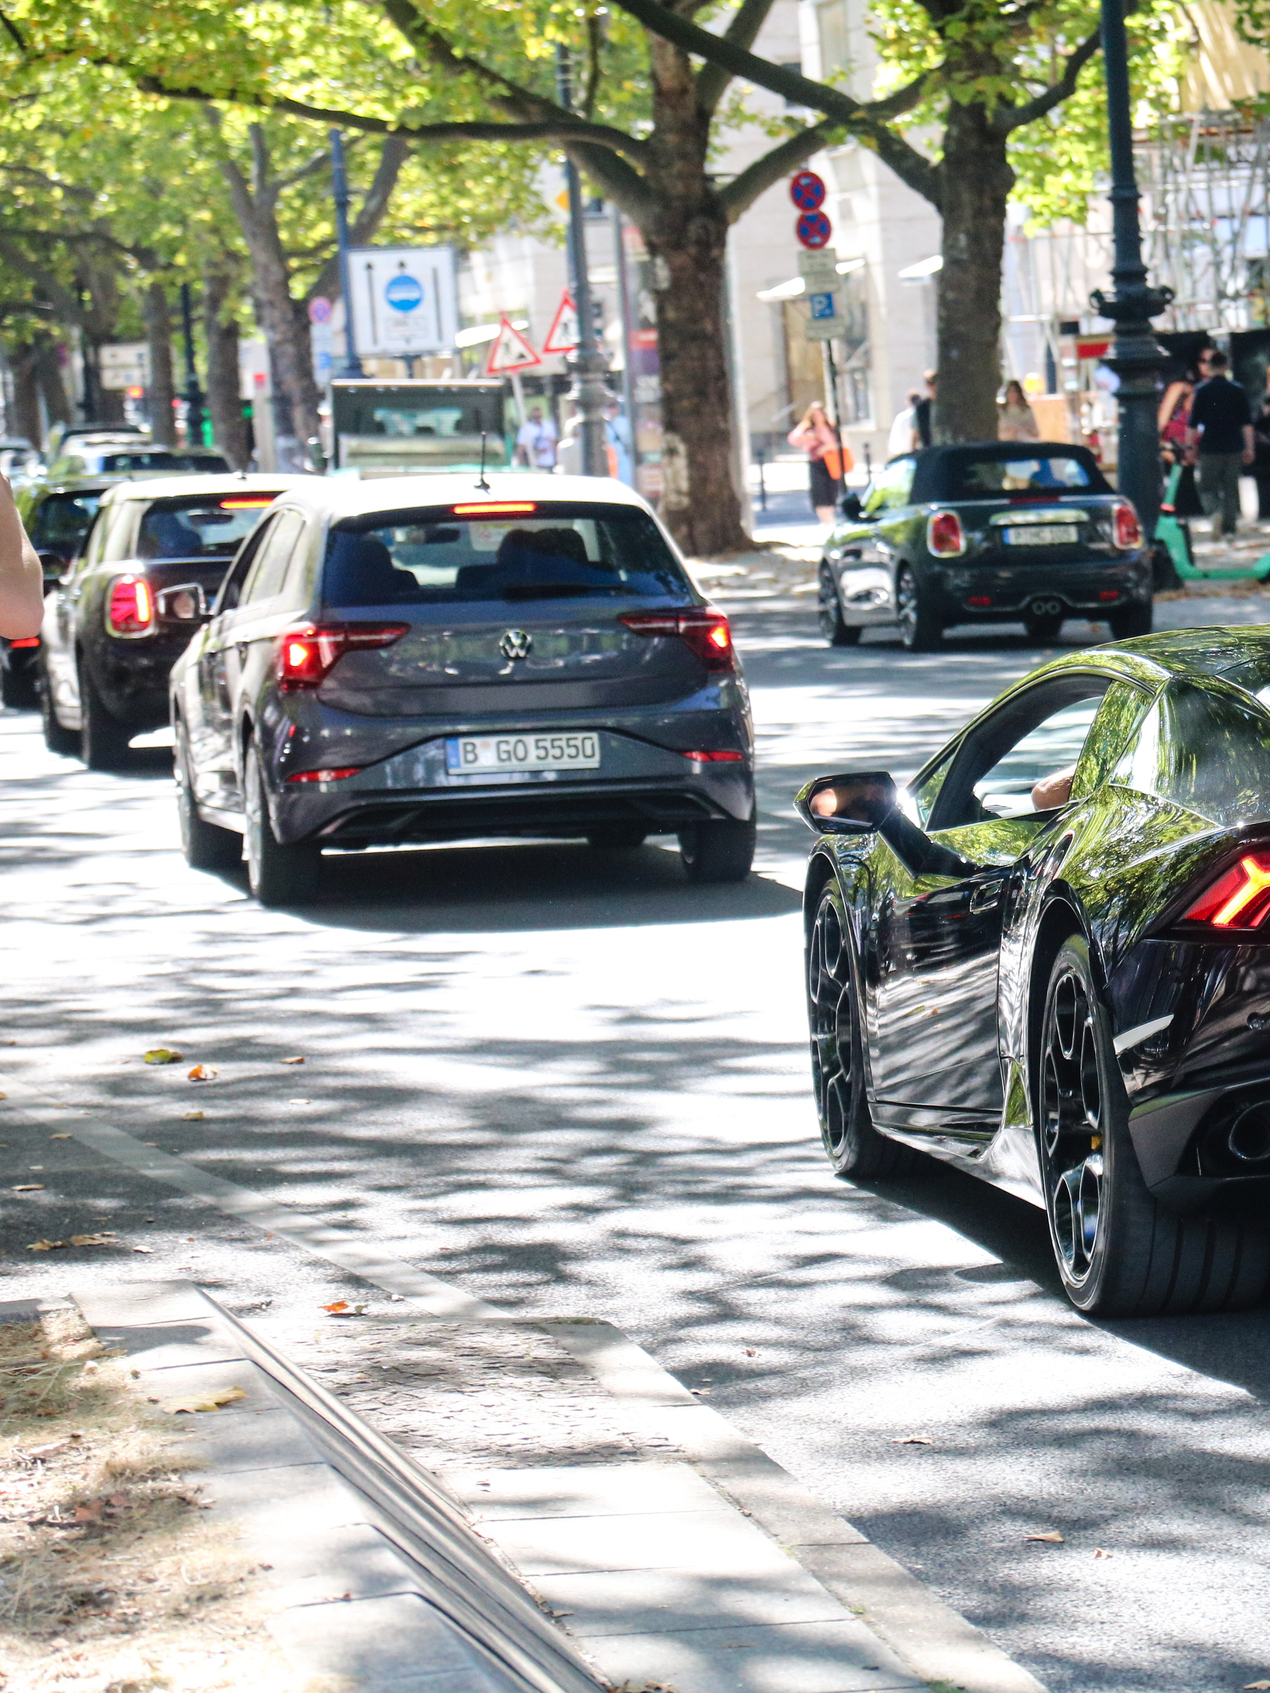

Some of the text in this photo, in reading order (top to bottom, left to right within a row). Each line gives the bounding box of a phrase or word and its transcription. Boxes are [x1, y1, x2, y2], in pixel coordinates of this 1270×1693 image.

[463, 736, 595, 764] B GO 5550
